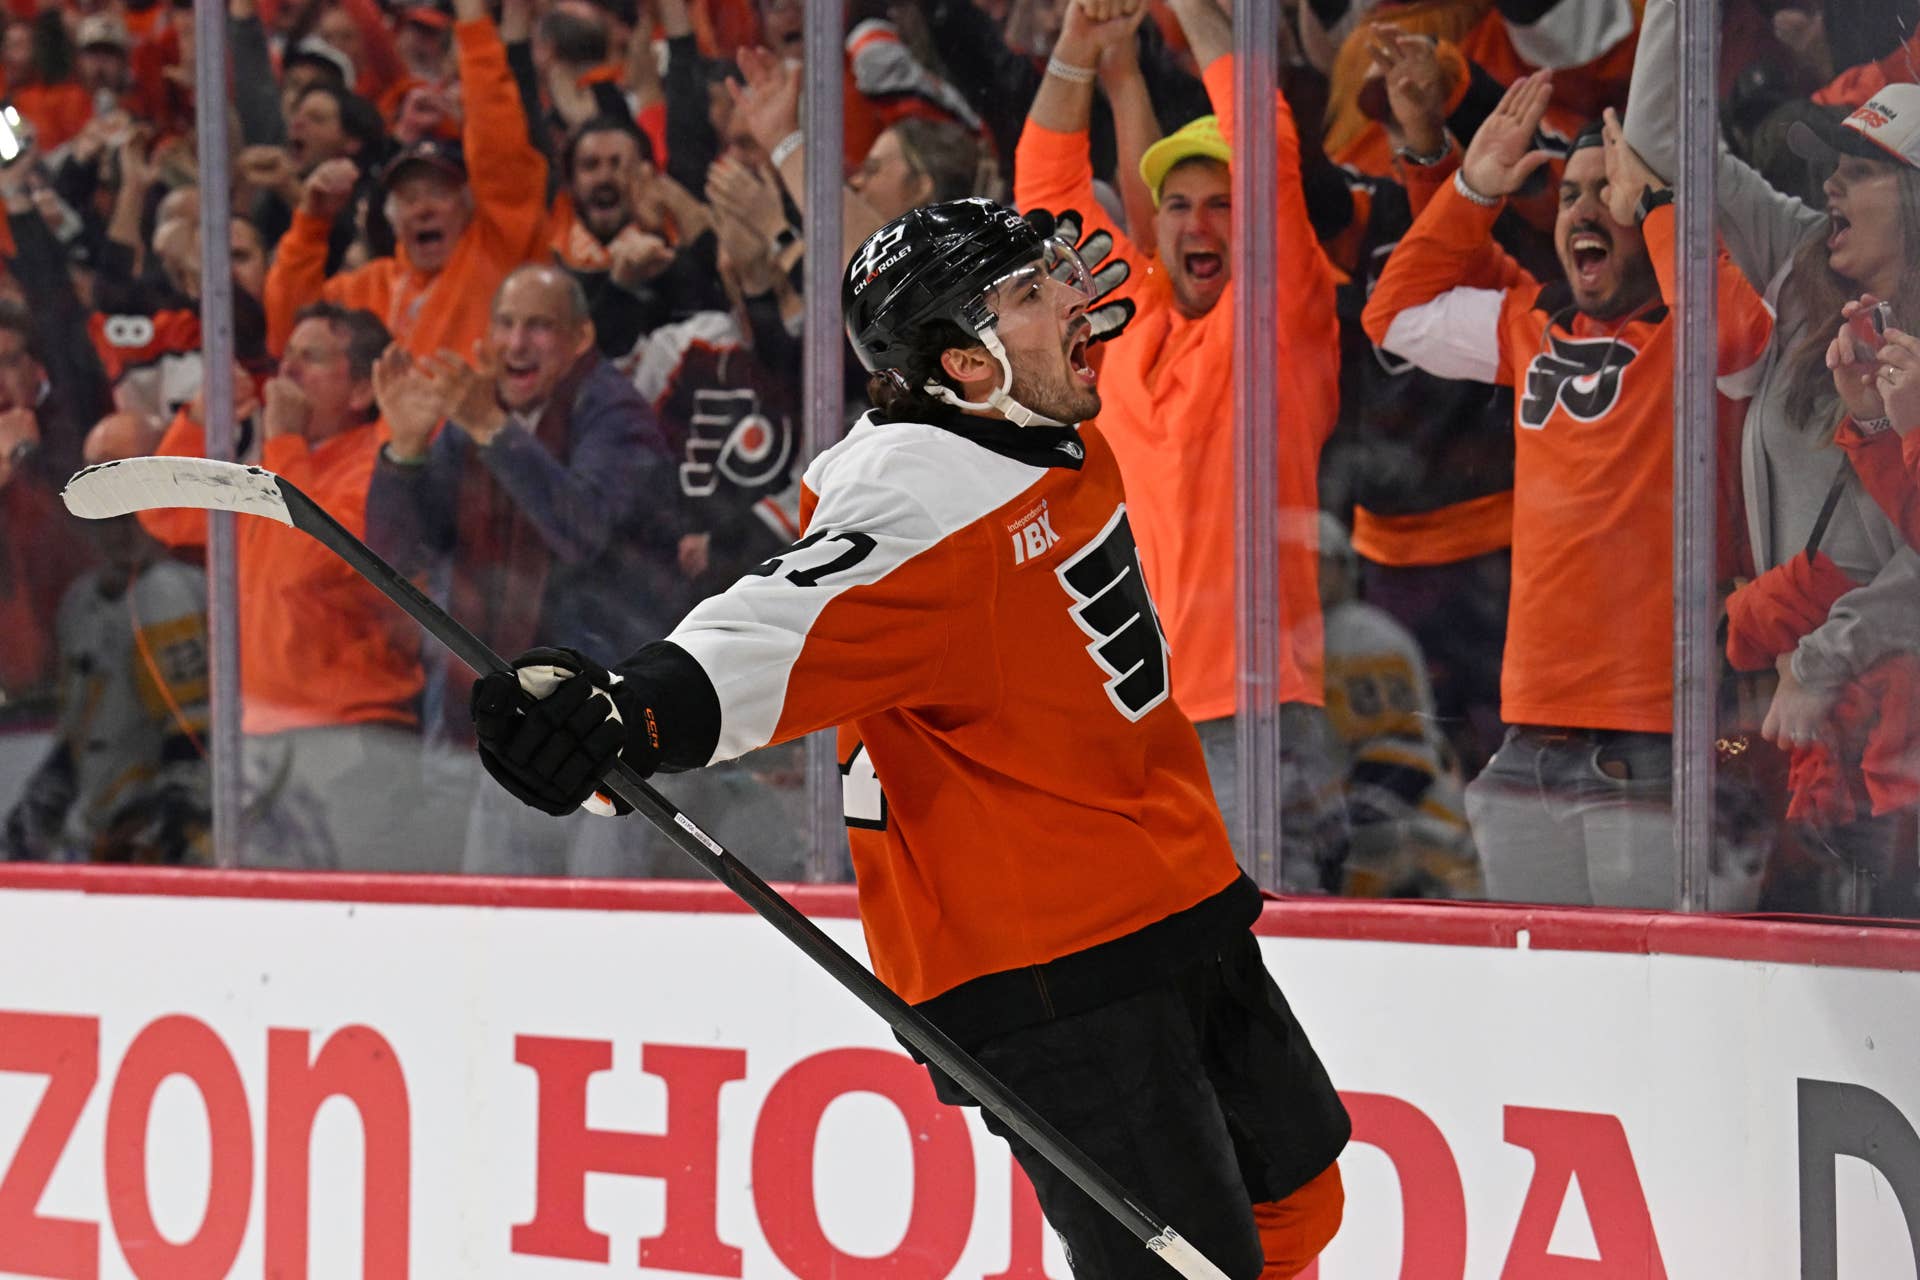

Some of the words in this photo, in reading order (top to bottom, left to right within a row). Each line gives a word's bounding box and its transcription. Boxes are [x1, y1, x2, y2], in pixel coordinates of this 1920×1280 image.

[853, 244, 912, 296] CHEVROLET
[1011, 509, 1061, 565] IBX
[510, 1033, 1670, 1280] HODA
